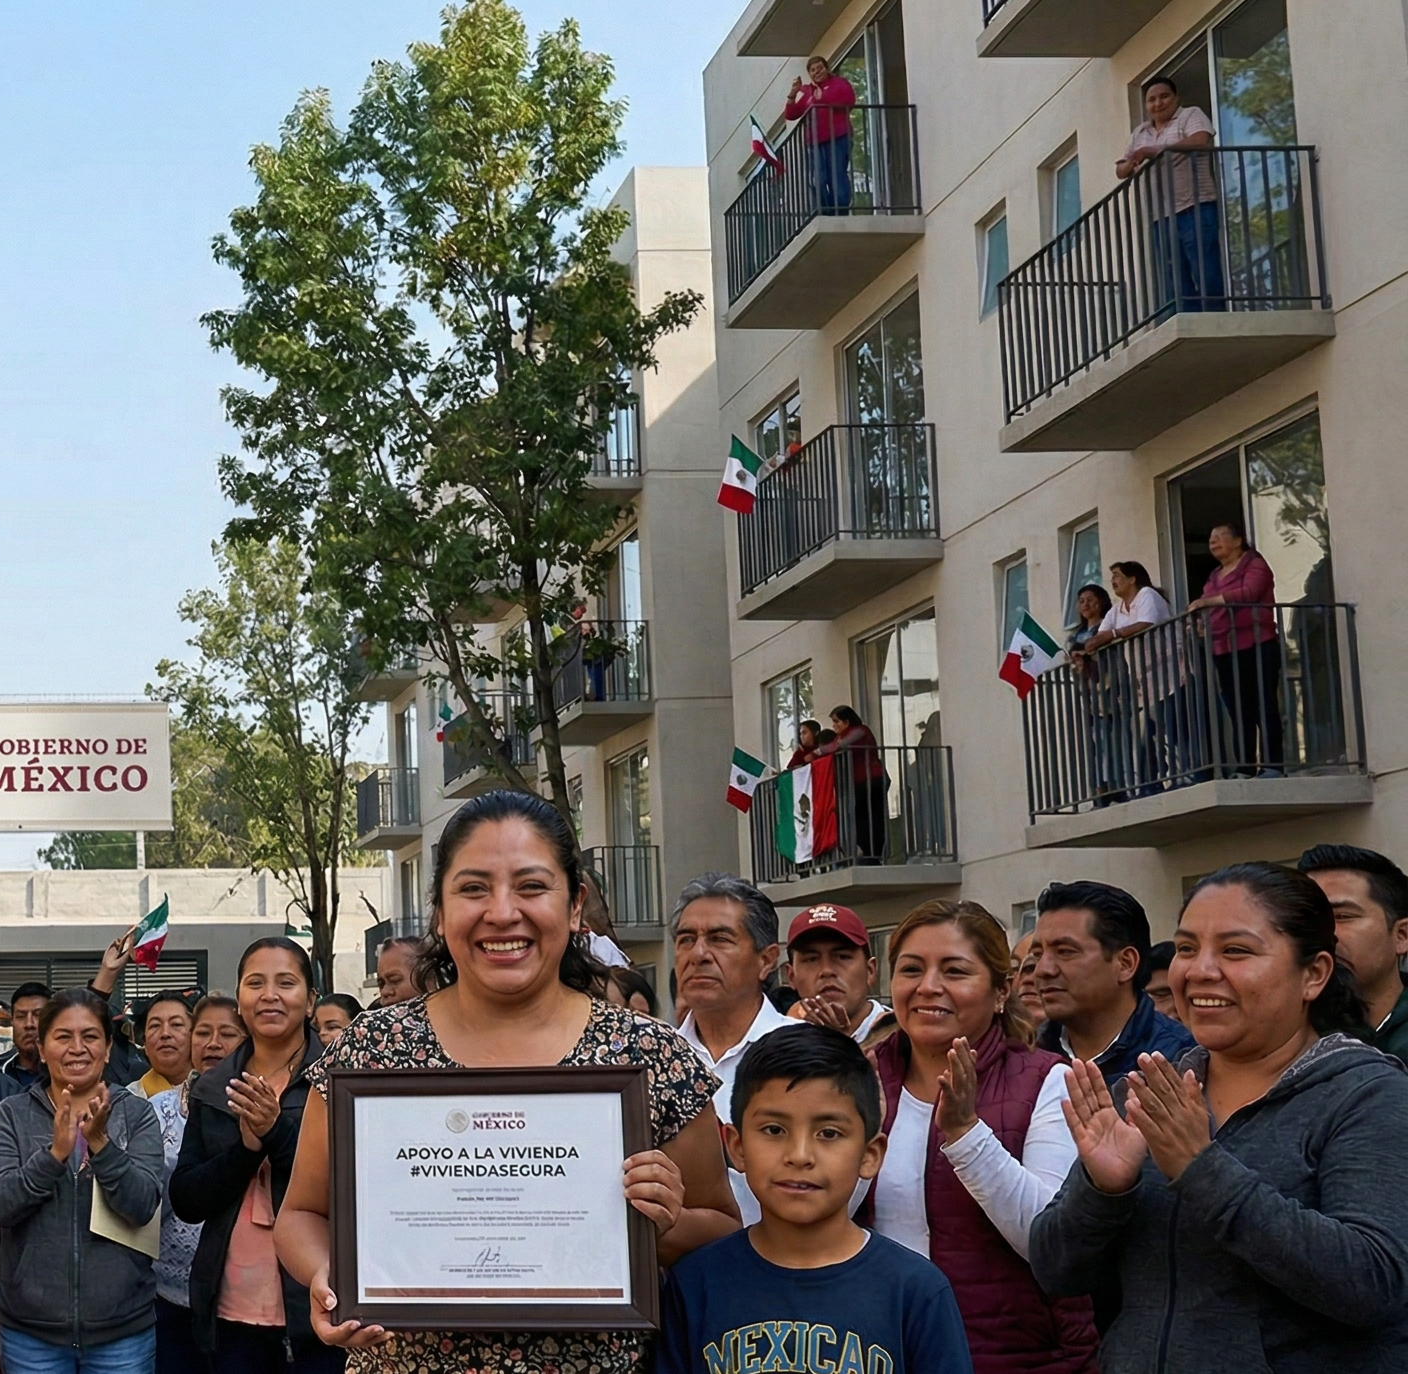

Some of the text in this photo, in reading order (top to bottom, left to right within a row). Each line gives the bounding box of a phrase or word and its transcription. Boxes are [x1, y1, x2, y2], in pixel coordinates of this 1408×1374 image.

[115, 738, 148, 756] DE
[472, 1117, 526, 1130] MÉXICO
[395, 1146, 580, 1160] APOYO A LA VIVIENDA
[409, 1164, 567, 1178] #VIVIENDASEGURA
